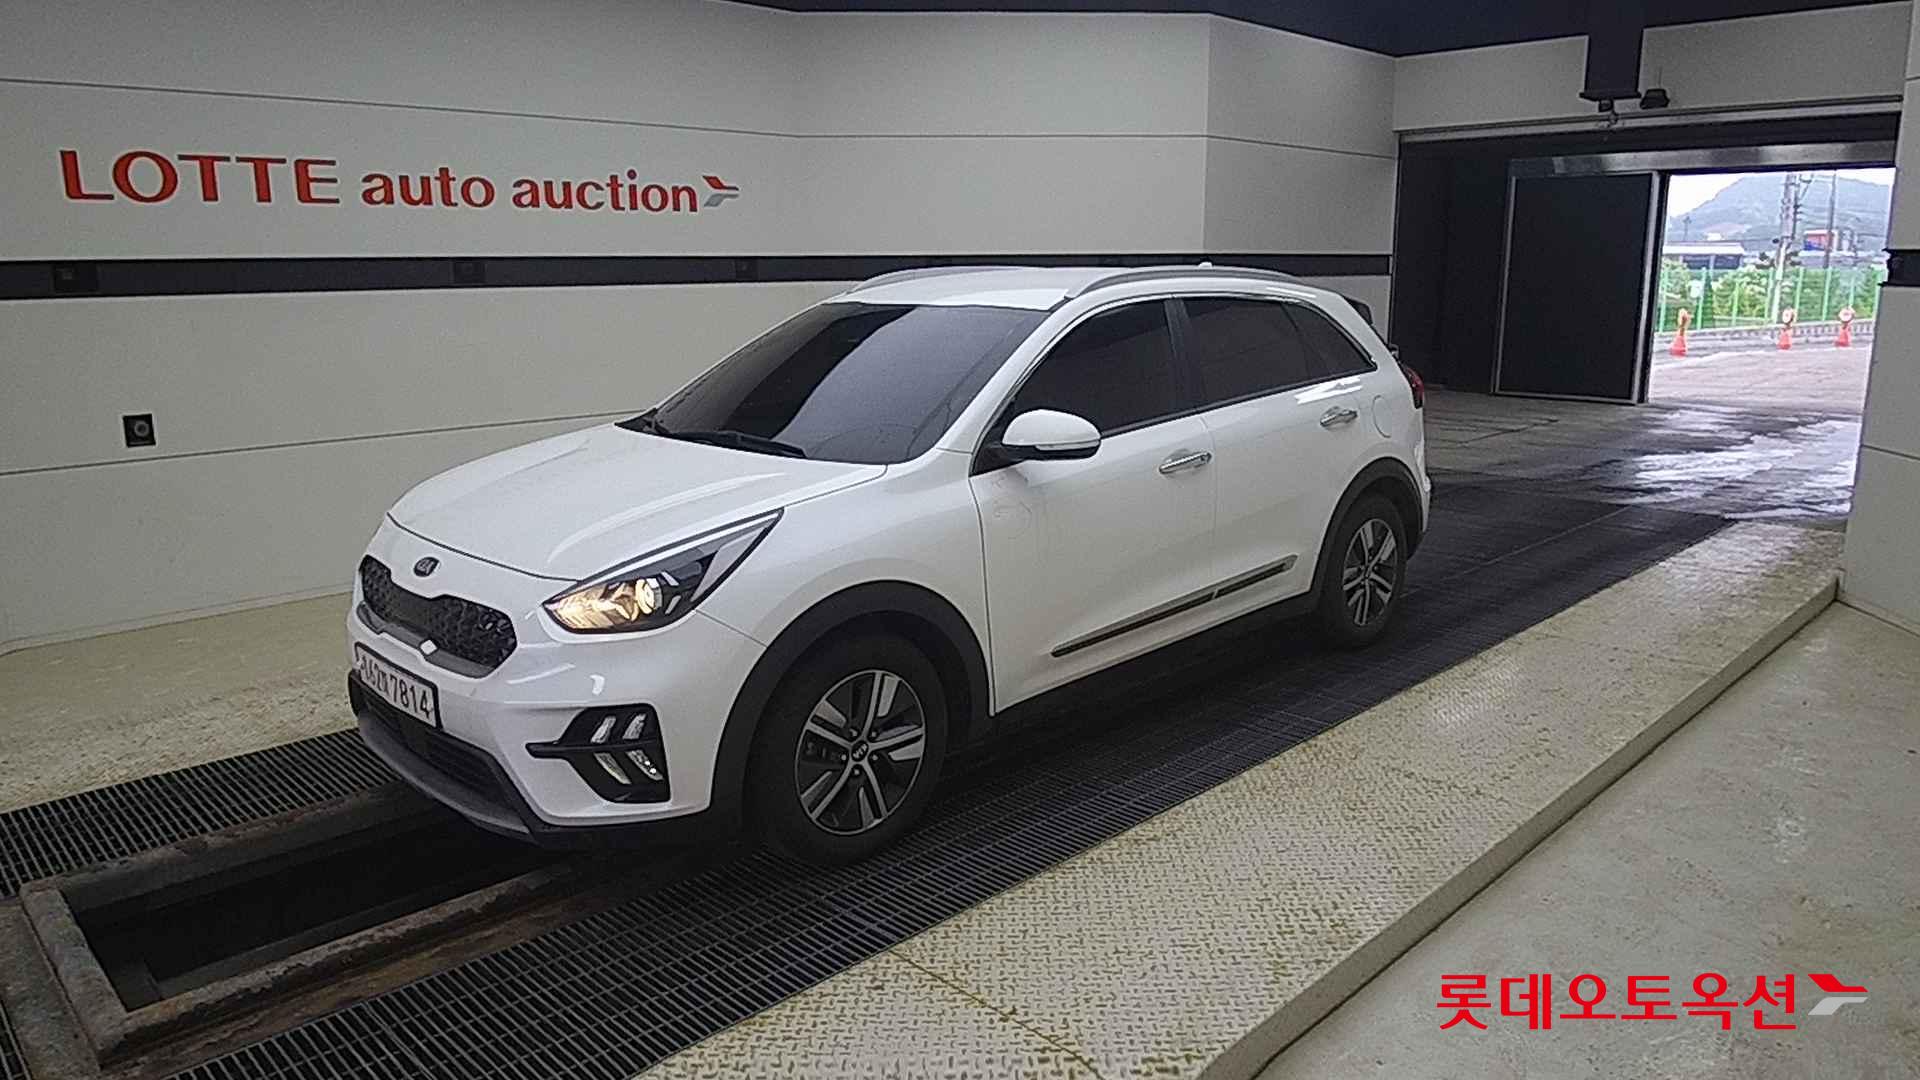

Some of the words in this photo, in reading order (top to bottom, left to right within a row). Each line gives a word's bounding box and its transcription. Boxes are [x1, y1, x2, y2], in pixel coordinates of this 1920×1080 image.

[59, 149, 340, 205] LOTTE
[361, 166, 496, 209] auto
[512, 169, 699, 213] auction
